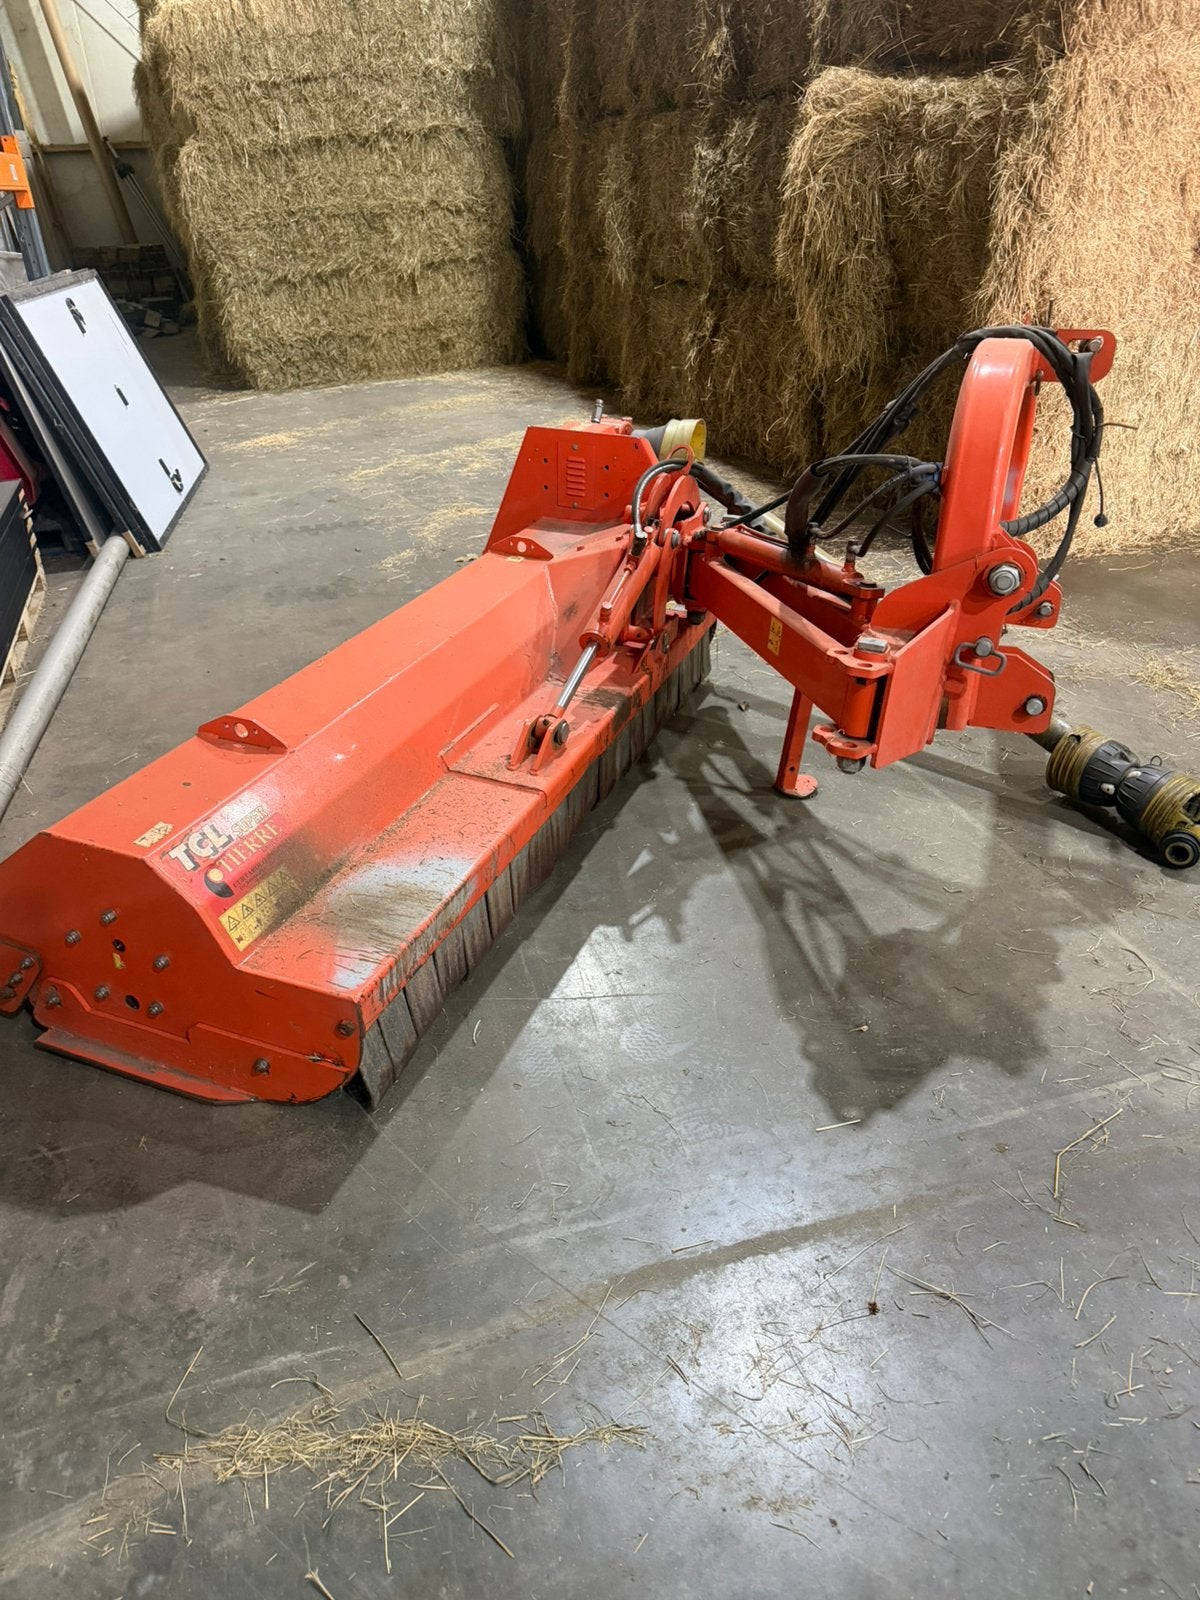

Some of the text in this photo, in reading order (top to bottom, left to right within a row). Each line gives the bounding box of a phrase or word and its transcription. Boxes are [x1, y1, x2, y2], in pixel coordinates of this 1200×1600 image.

[168, 824, 233, 872] TCL
[231, 805, 269, 838] SUPER
[216, 820, 282, 873] TIERRE
